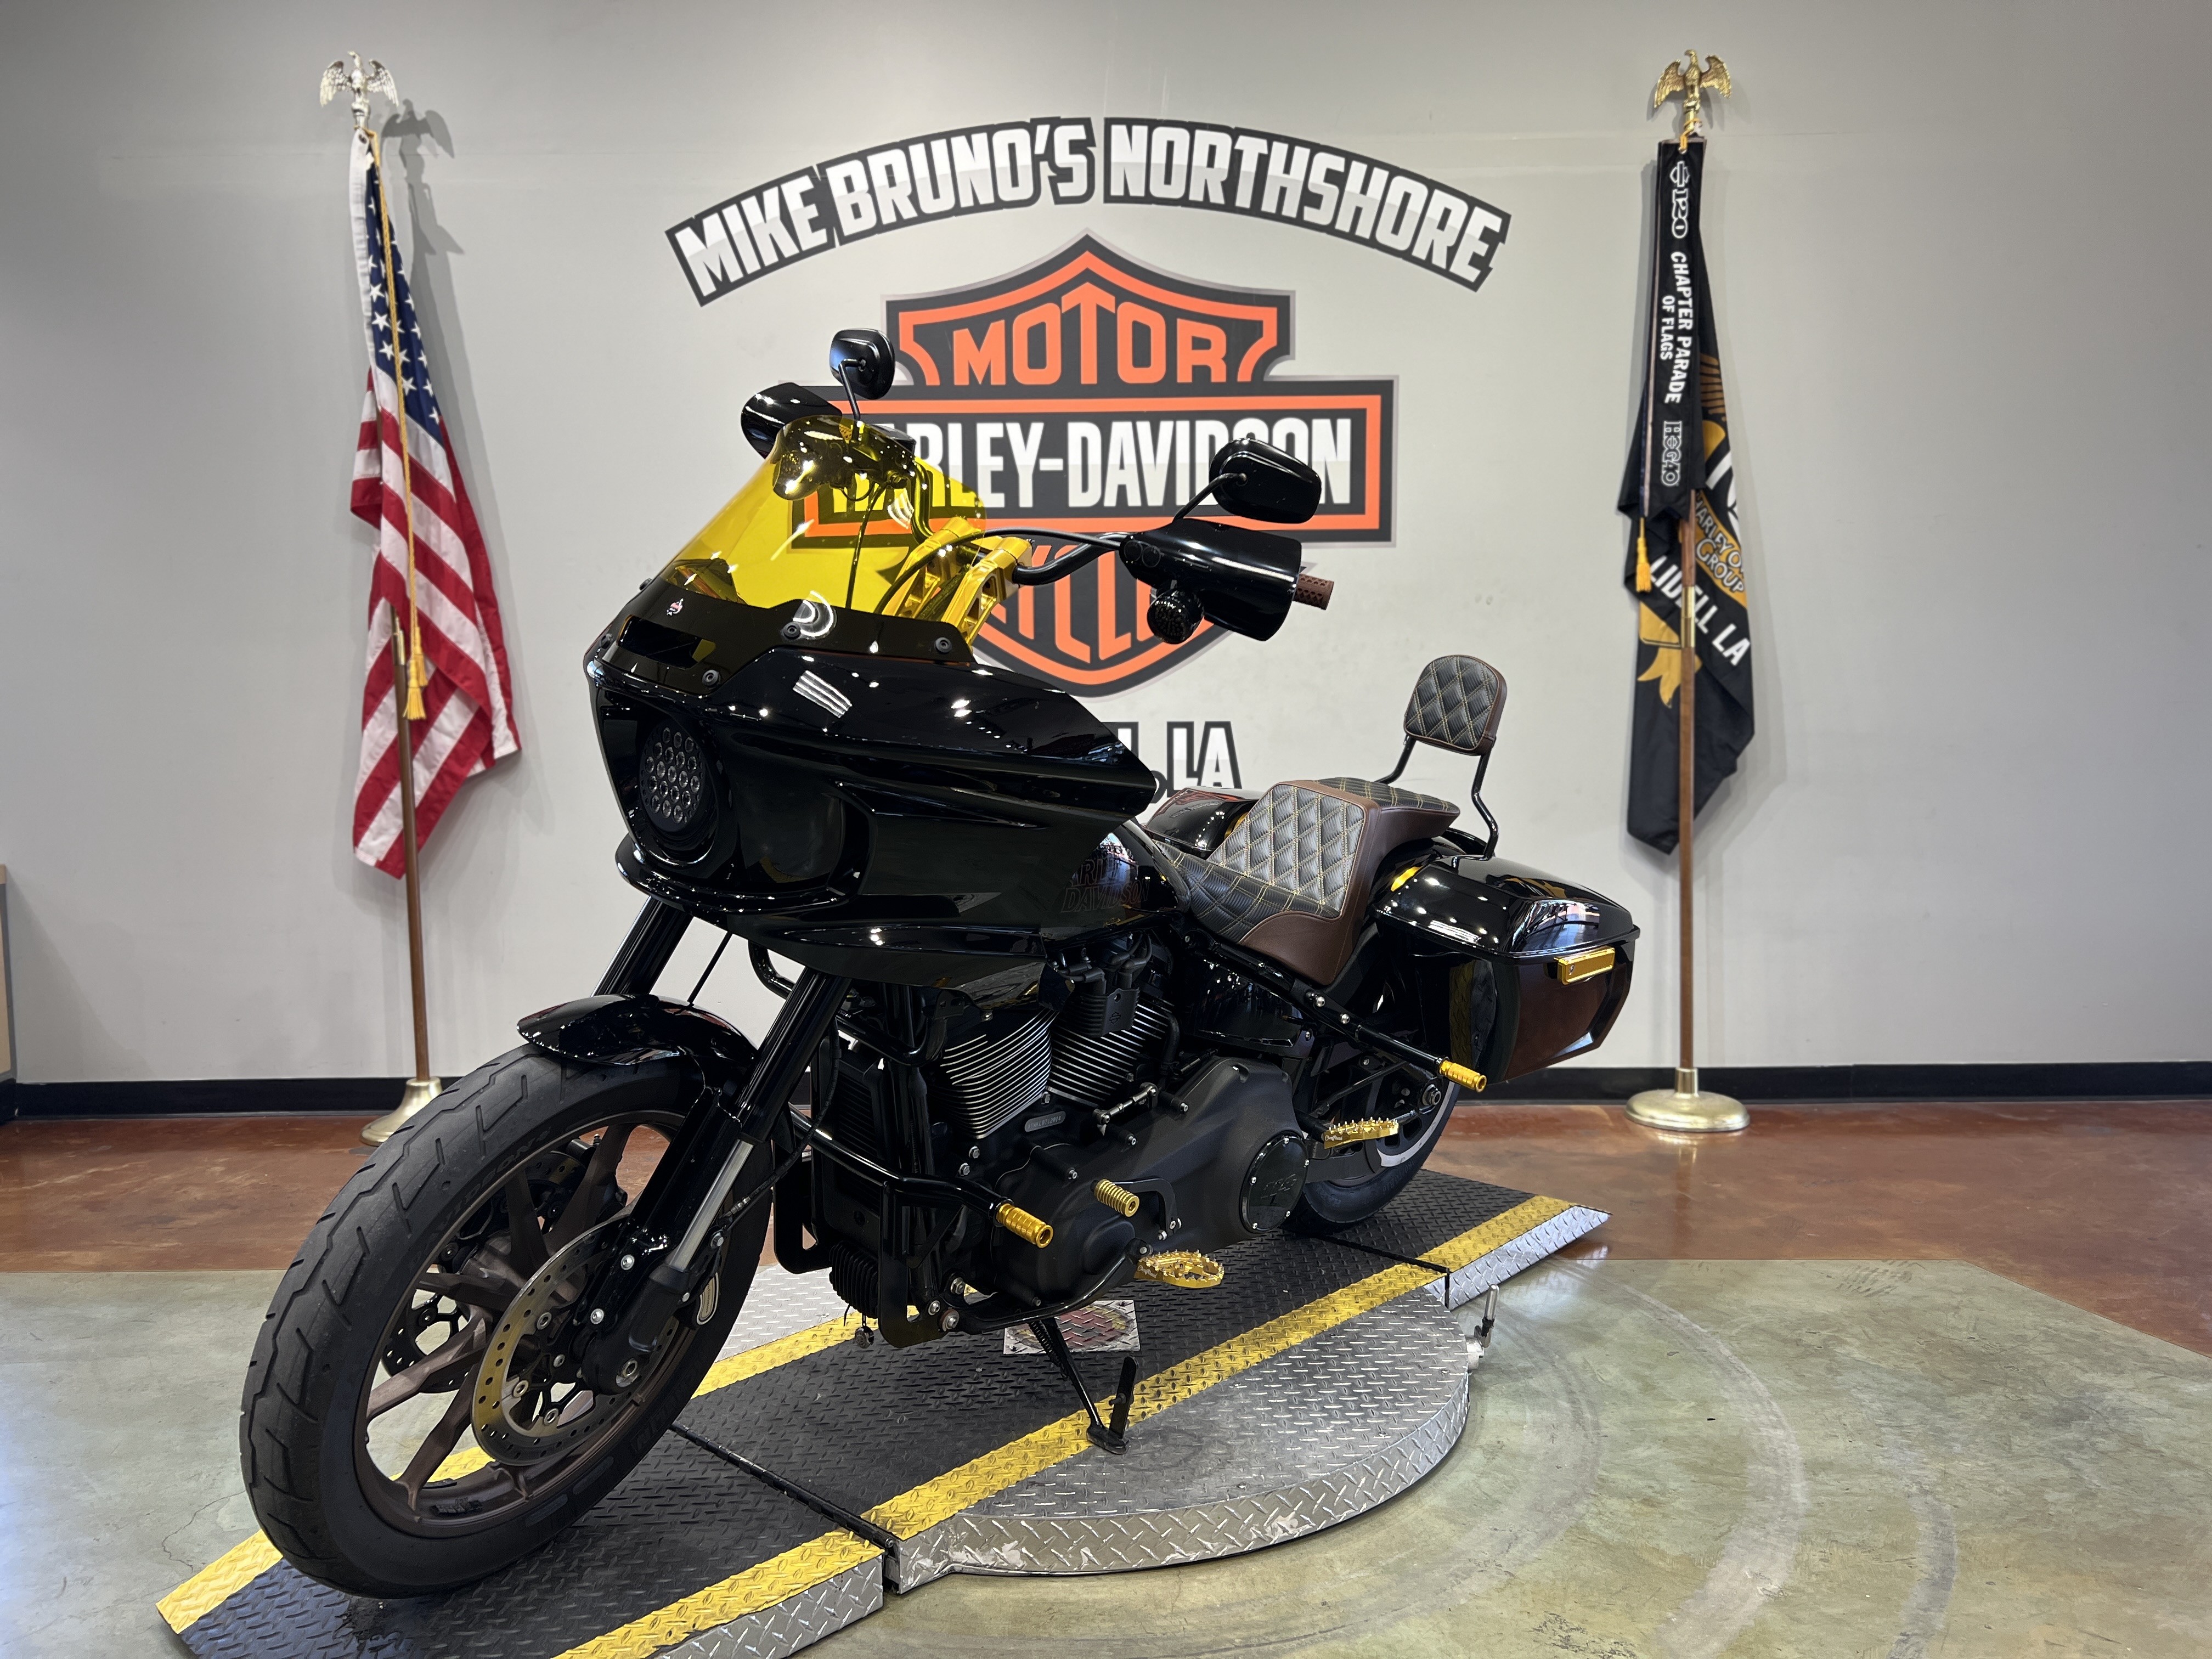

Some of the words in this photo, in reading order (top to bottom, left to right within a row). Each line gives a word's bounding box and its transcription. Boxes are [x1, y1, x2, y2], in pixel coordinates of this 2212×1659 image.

[670, 171, 831, 301] MIKE
[822, 121, 1092, 240] BRUNO'S
[1107, 121, 1506, 287] NORTHSHORE
[1671, 188, 1688, 239] 120
[1662, 295, 1675, 312] OF
[1671, 251, 1694, 330] CHAPTER
[953, 281, 1227, 385] MOTOR
[1660, 317, 1674, 360] FLAGS
[1664, 336, 1692, 404] PARADE
[833, 417, 1351, 514] RLEY-DAVIDN
[1696, 538, 1745, 592] GROUP
[1711, 623, 1751, 667] LA
[1170, 724, 1239, 794] LA
[1059, 879, 1150, 913] DAVIDSON
